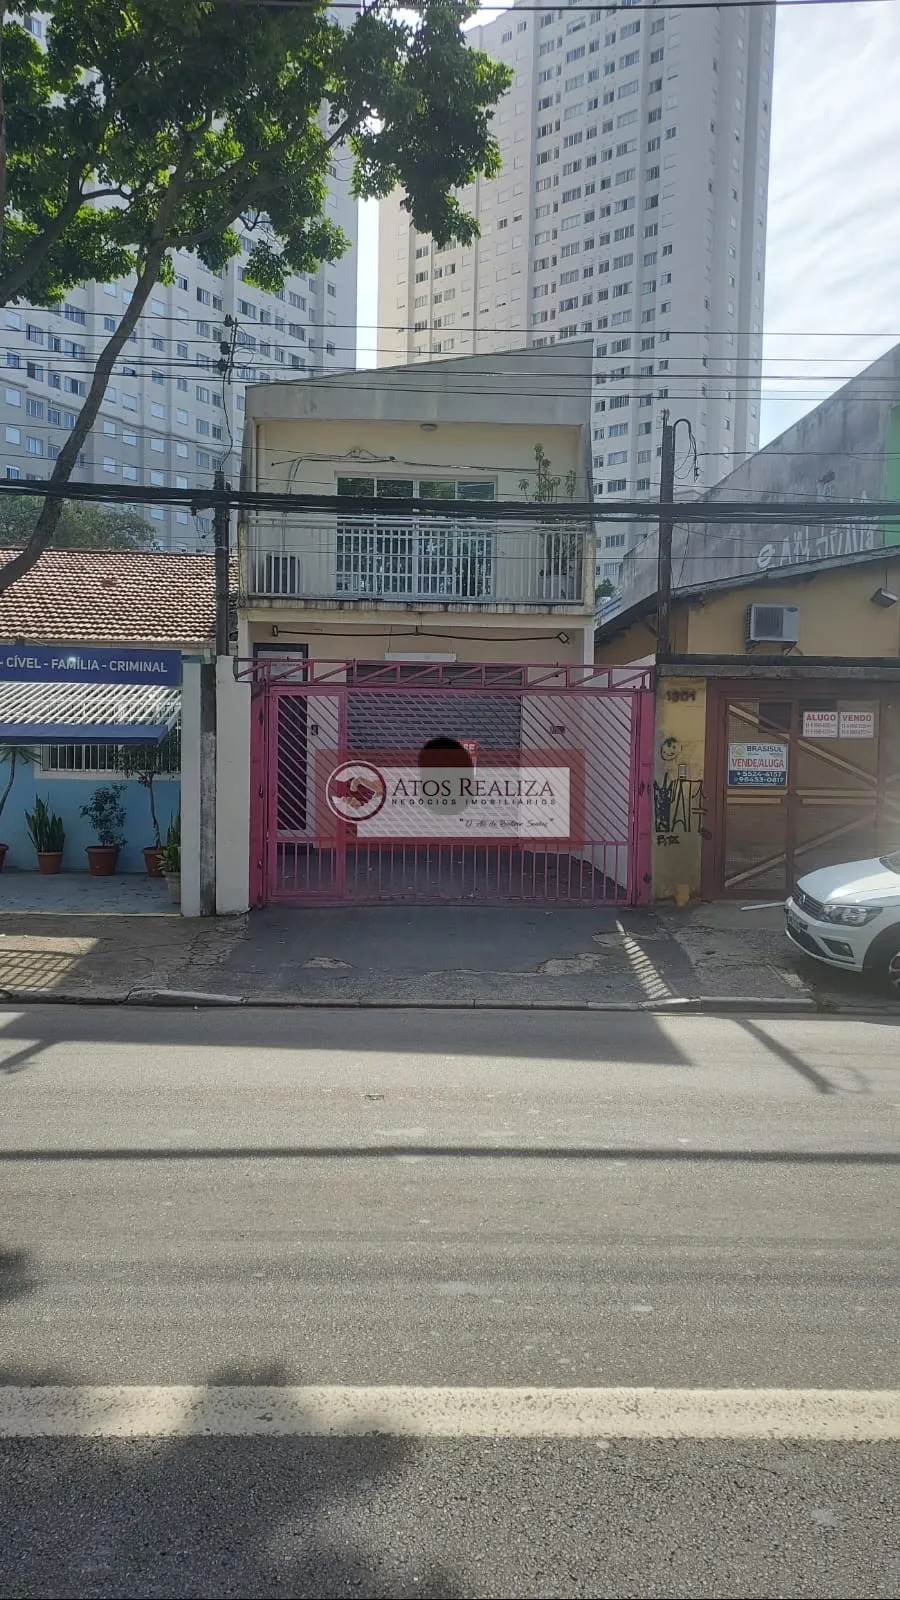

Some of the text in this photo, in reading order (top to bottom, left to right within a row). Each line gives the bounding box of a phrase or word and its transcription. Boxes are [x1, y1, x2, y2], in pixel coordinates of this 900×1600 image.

[6, 654, 41, 669] CÍVEL
[51, 656, 100, 671] FAMÍLIA
[109, 660, 168, 673] CRIMINAL
[806, 713, 836, 721] ALUGO
[842, 714, 872, 722] VENDO
